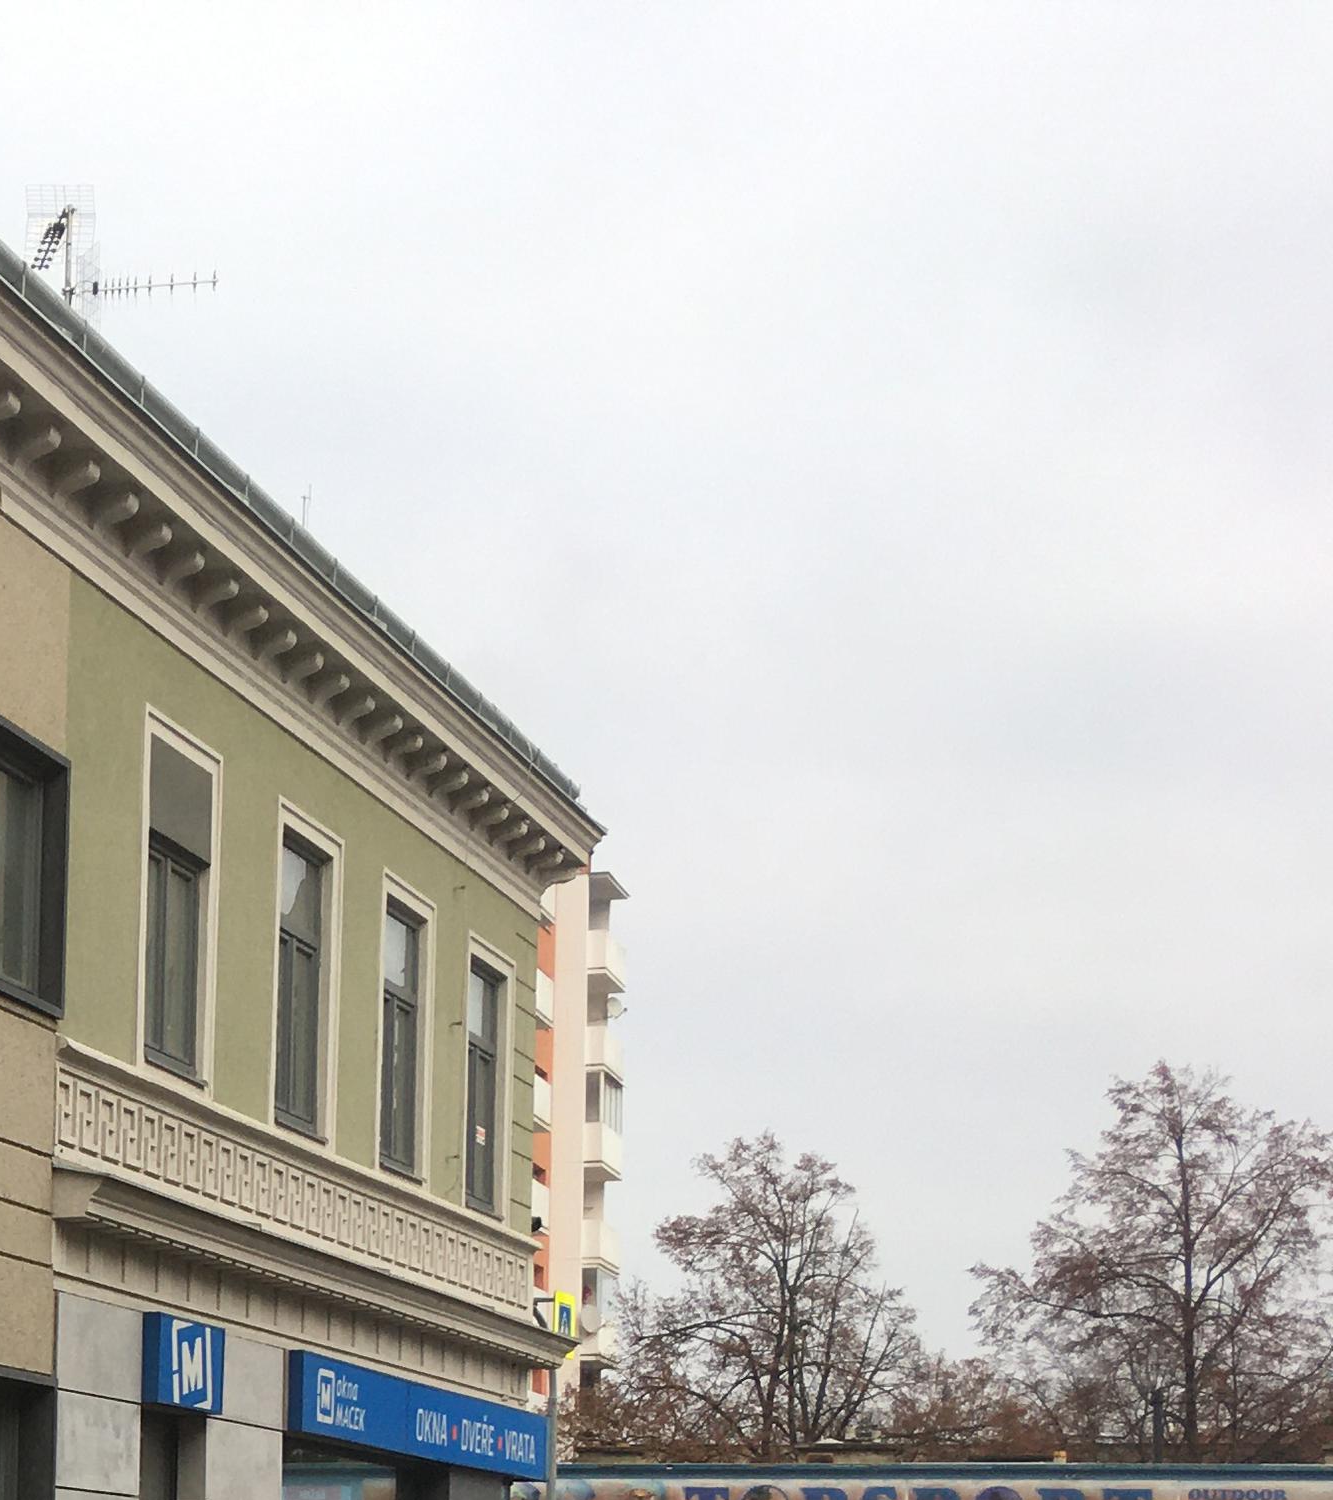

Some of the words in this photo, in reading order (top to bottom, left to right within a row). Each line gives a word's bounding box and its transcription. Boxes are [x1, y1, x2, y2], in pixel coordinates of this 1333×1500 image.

[336, 1375, 359, 1401] okna
[334, 1406, 366, 1432] MACEK
[415, 1408, 448, 1447] OKNA
[460, 1414, 495, 1457] DVEŘE
[504, 1429, 536, 1466] VRATA
[1188, 1488, 1288, 1500] OUTDOOR
